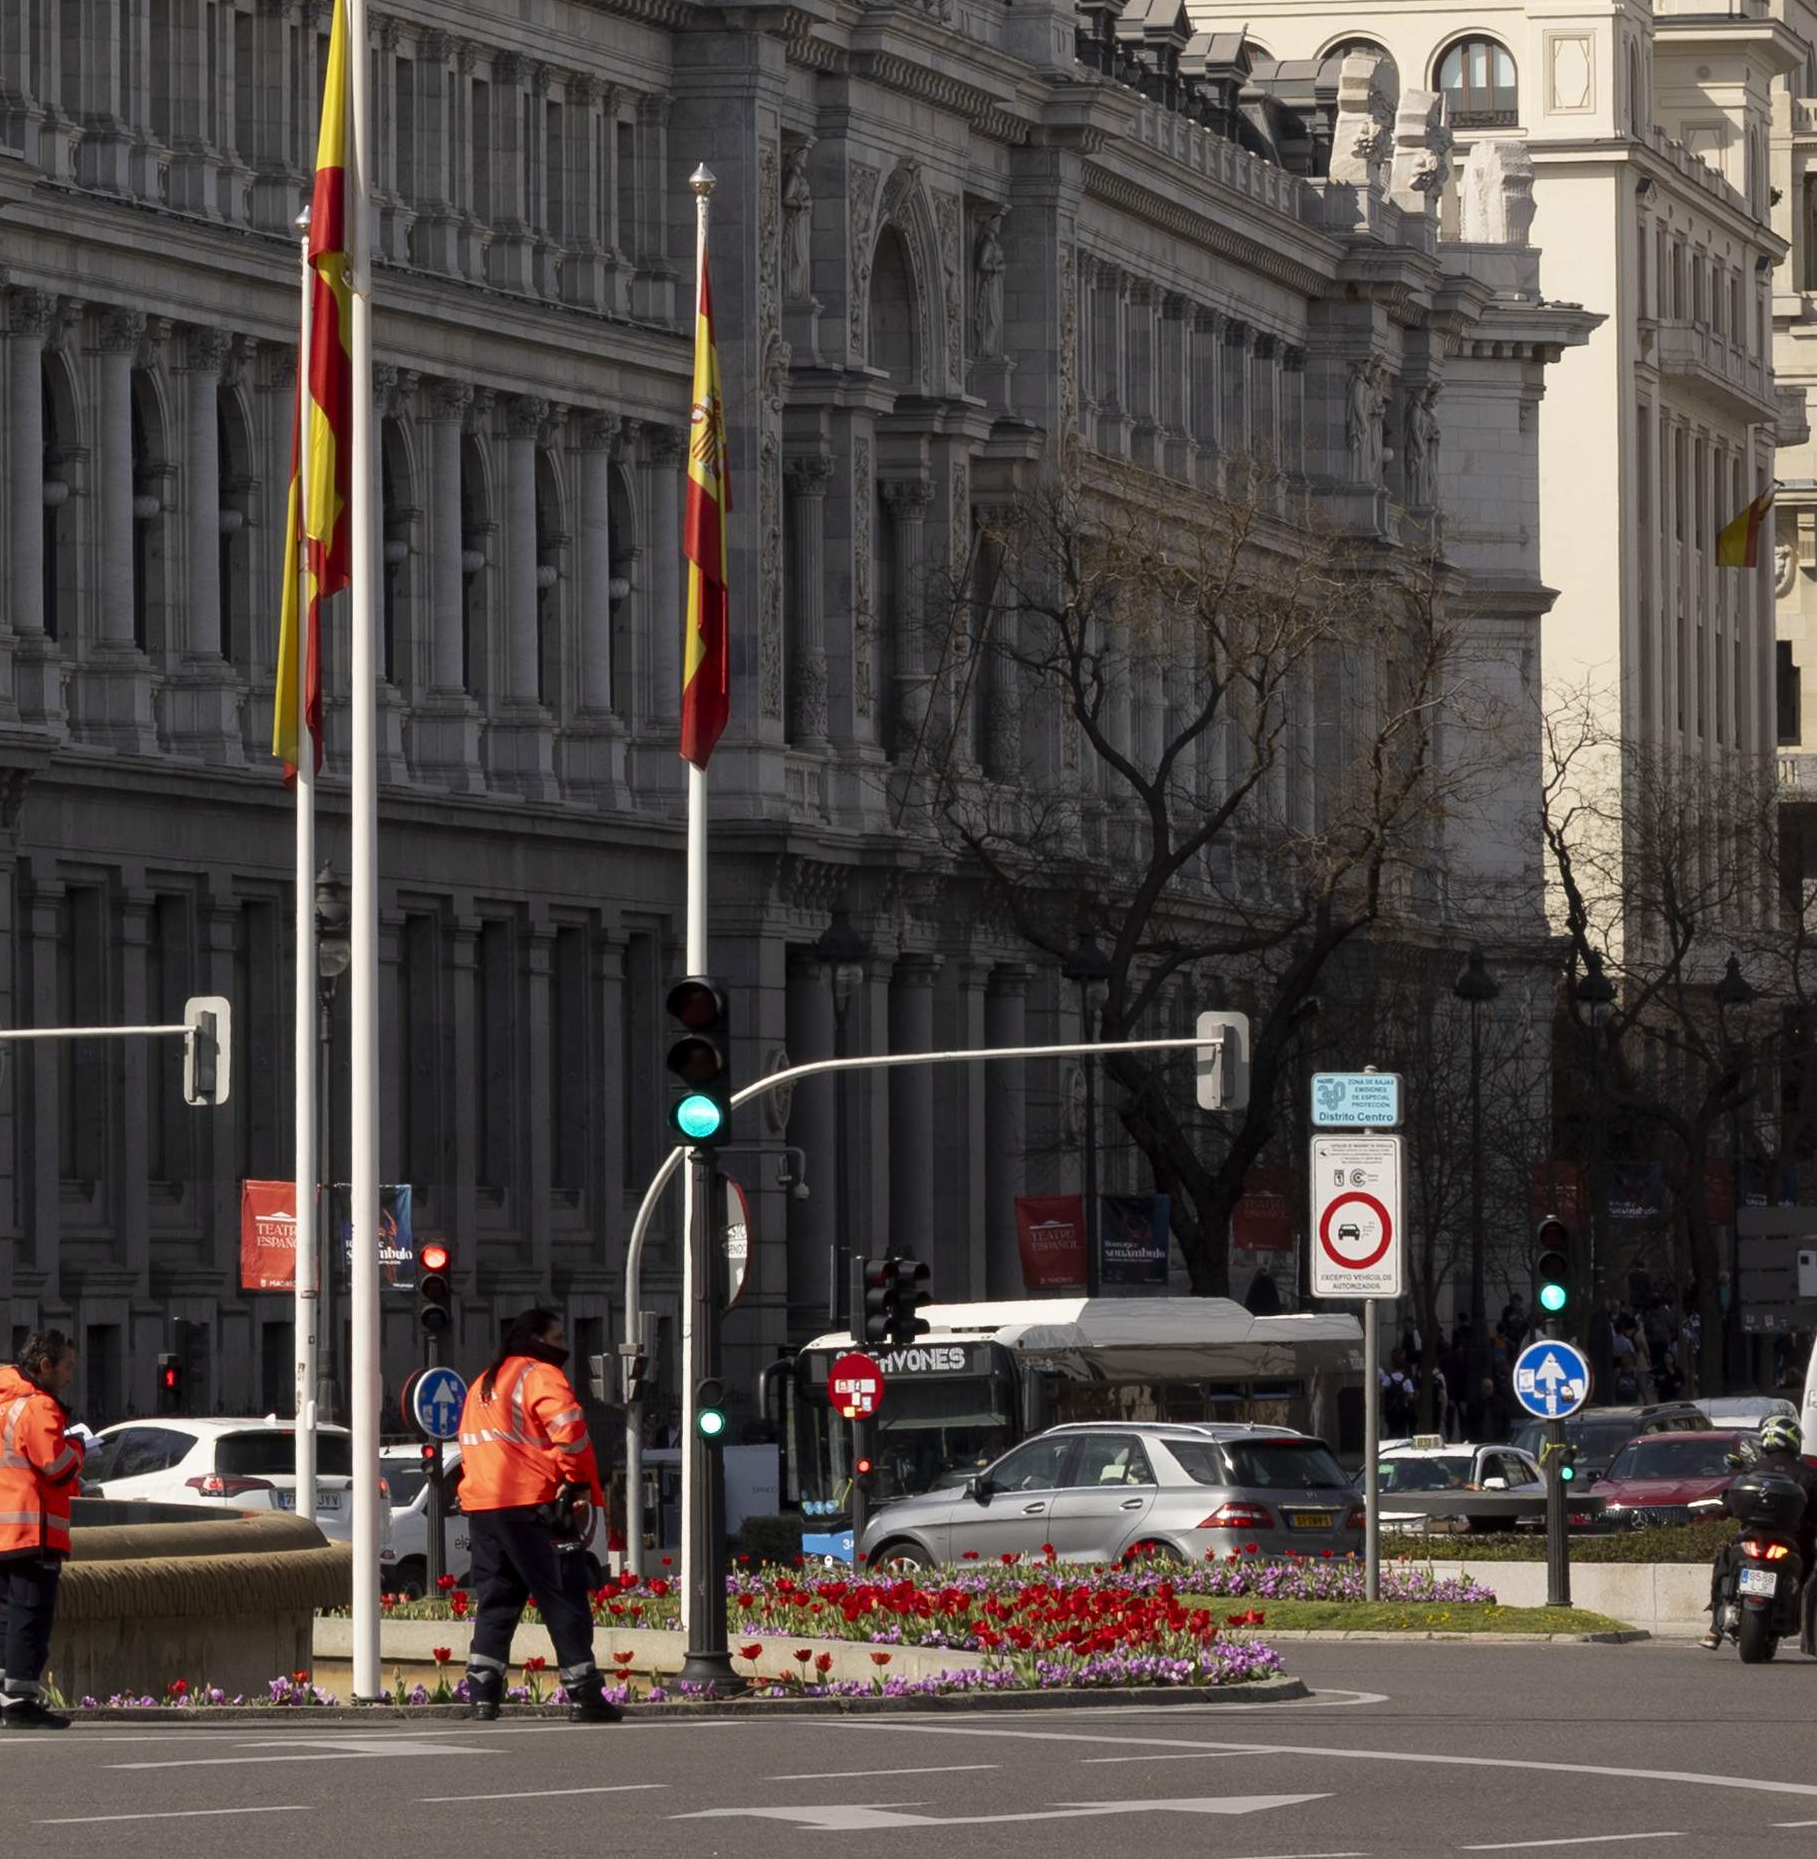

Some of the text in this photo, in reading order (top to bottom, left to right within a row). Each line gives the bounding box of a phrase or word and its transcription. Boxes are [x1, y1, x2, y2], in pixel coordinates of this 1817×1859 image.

[1319, 1111, 1394, 1122] Distrito Centro
[255, 1223, 297, 1236] TEATR
